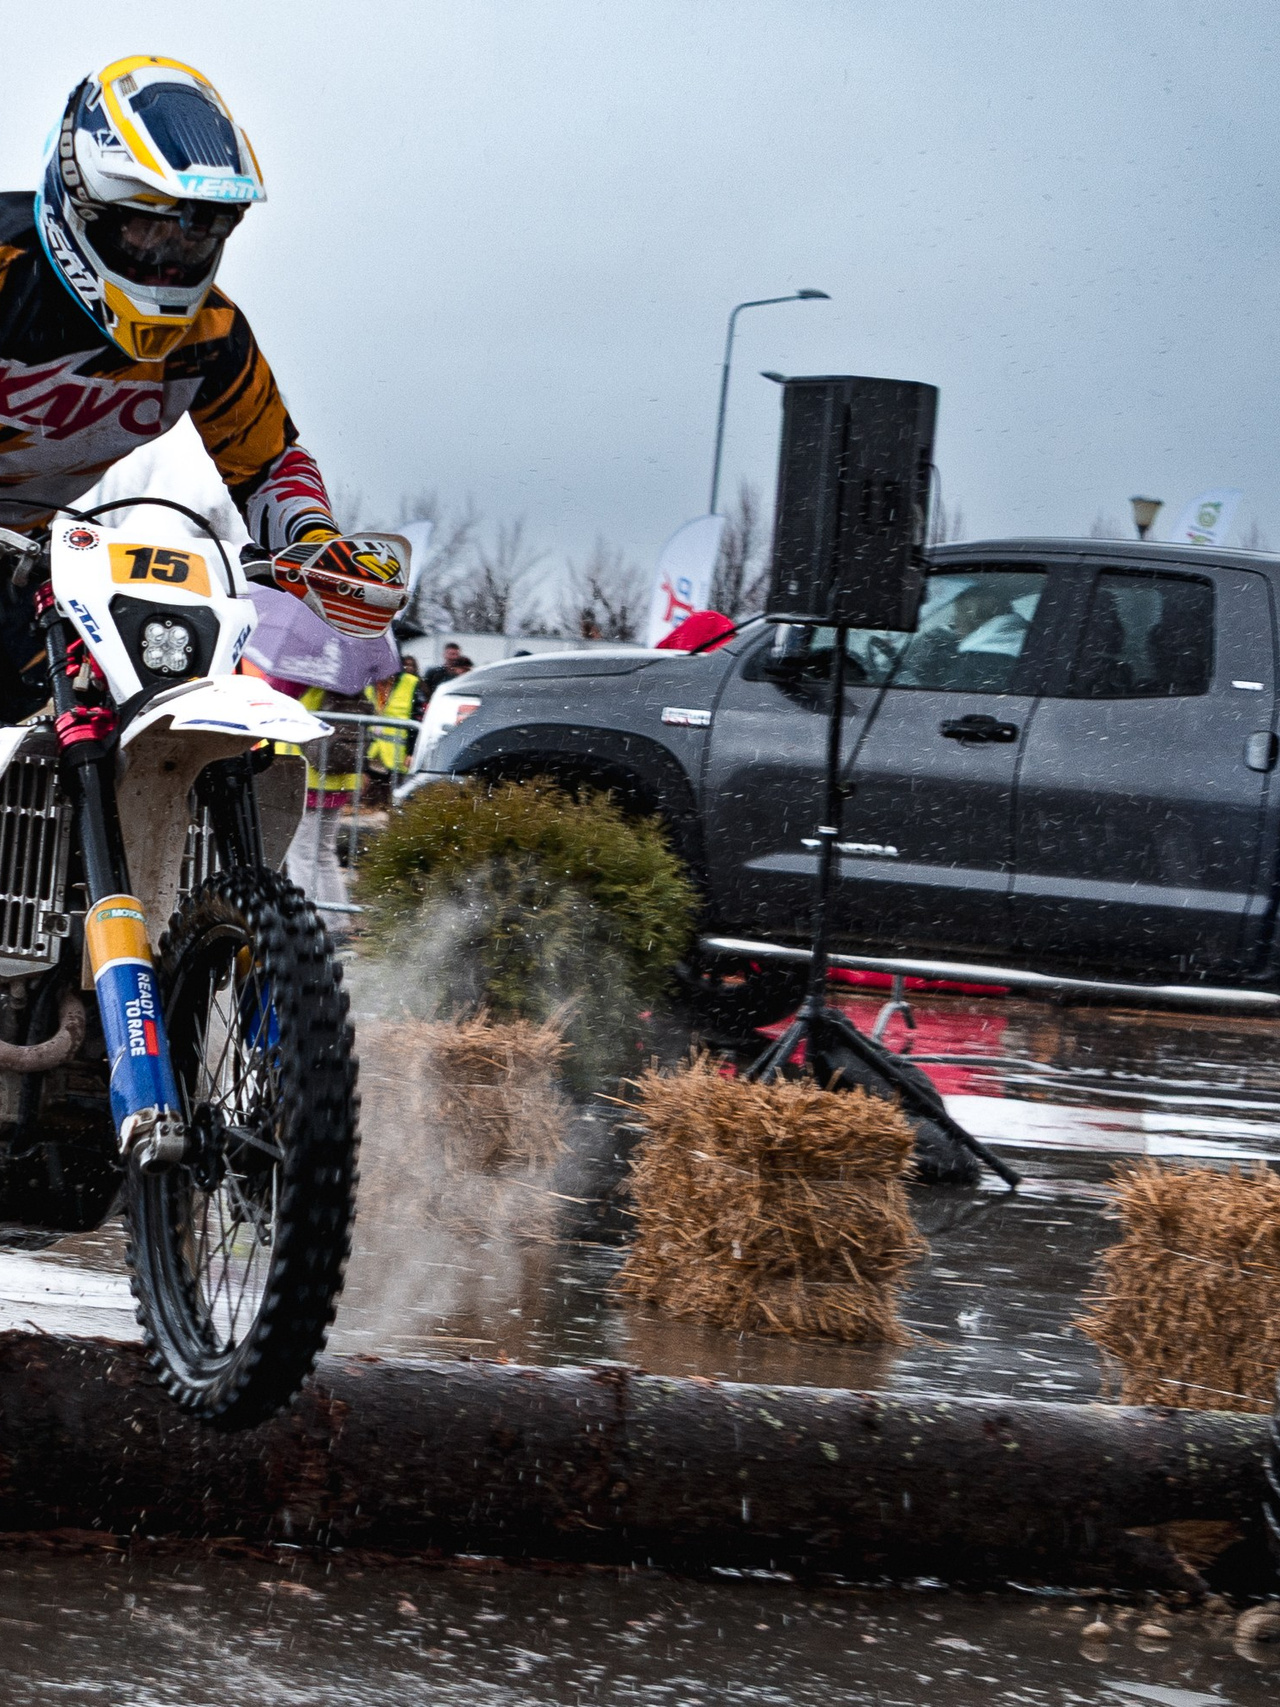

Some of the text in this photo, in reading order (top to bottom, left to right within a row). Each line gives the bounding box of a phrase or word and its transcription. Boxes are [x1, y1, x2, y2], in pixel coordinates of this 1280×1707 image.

[125, 547, 190, 583] 15
[68, 599, 103, 644] KTM
[137, 972, 156, 1019] READY
[125, 998, 147, 1057] TO RACE
